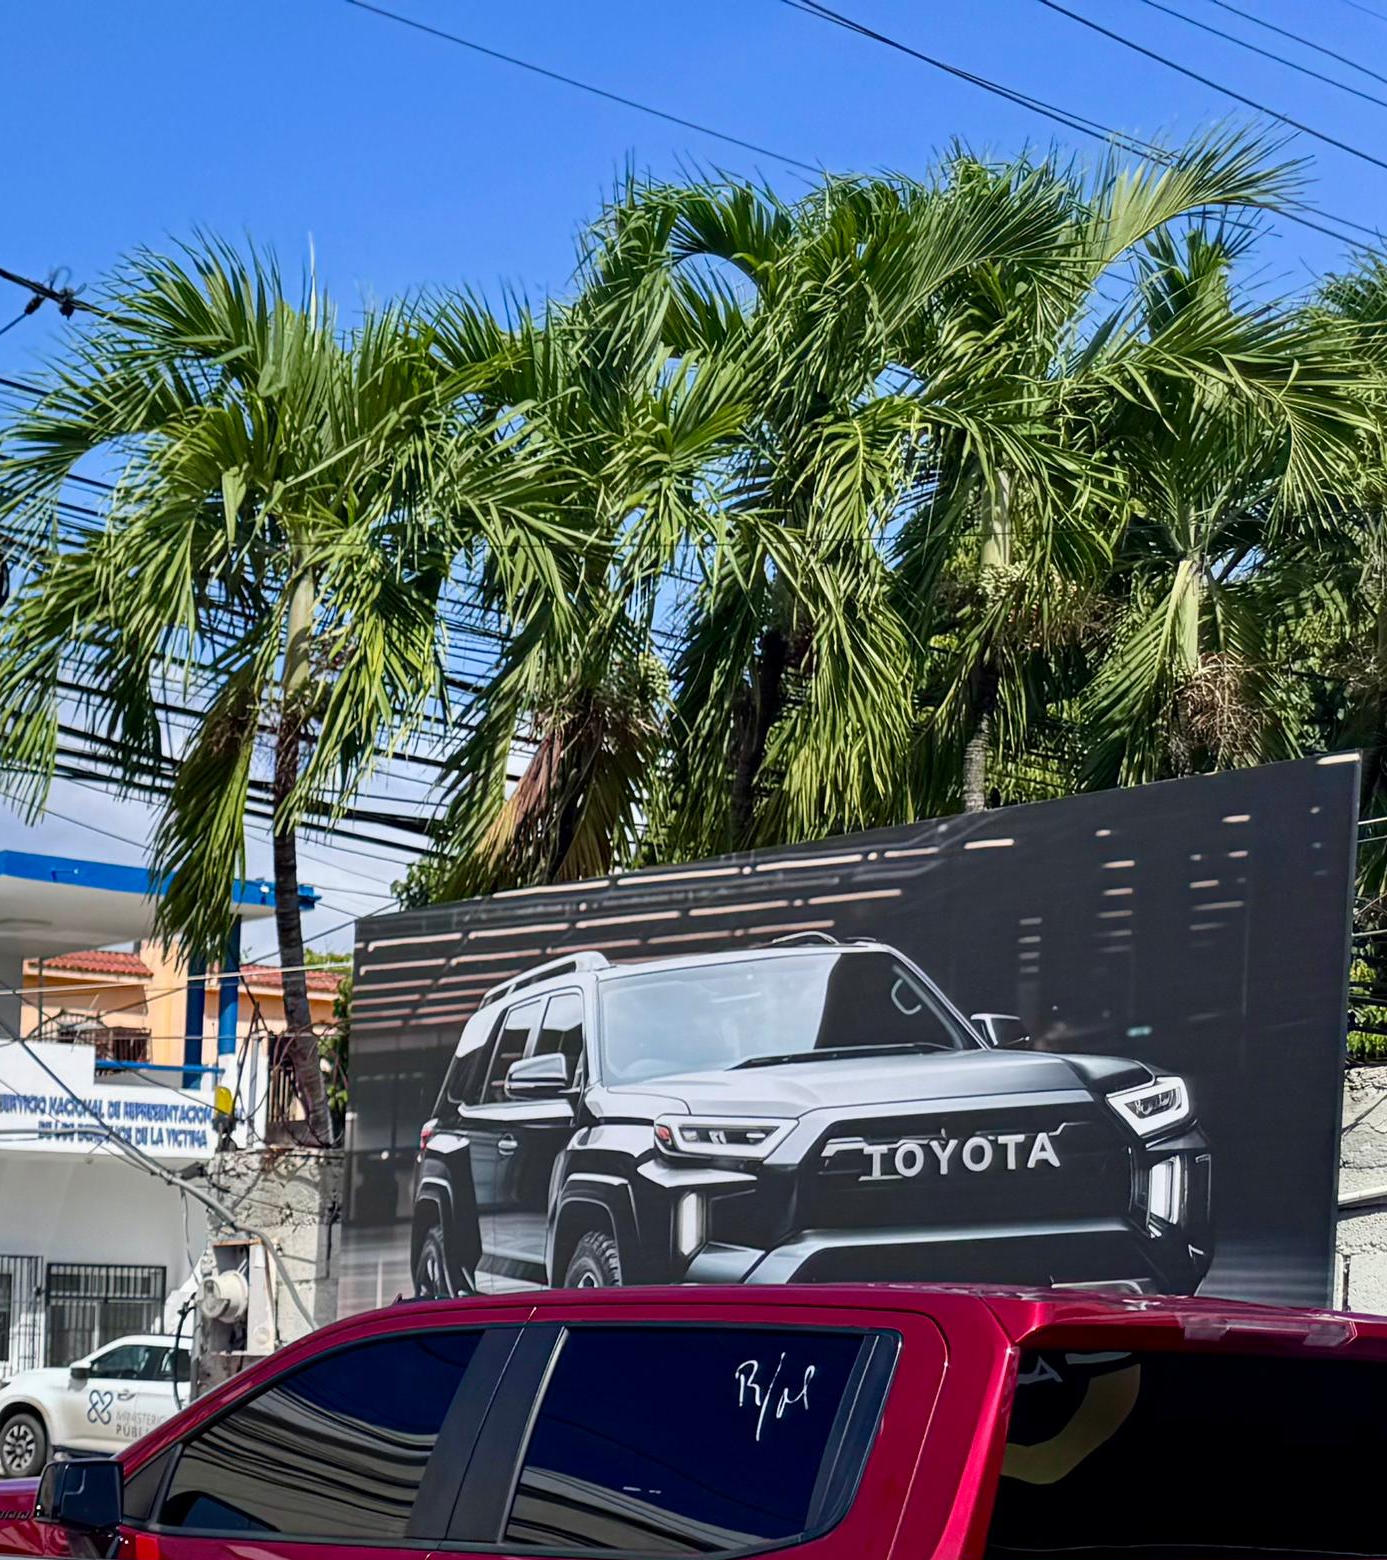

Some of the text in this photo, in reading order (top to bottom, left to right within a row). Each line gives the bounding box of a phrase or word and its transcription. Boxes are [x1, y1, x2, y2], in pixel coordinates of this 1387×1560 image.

[49, 1096, 104, 1120] NACIONAL
[107, 1100, 121, 1120] DE
[135, 1126, 149, 1146] DE
[150, 1127, 164, 1147] LA
[863, 1132, 1061, 1178] TOYOTA
